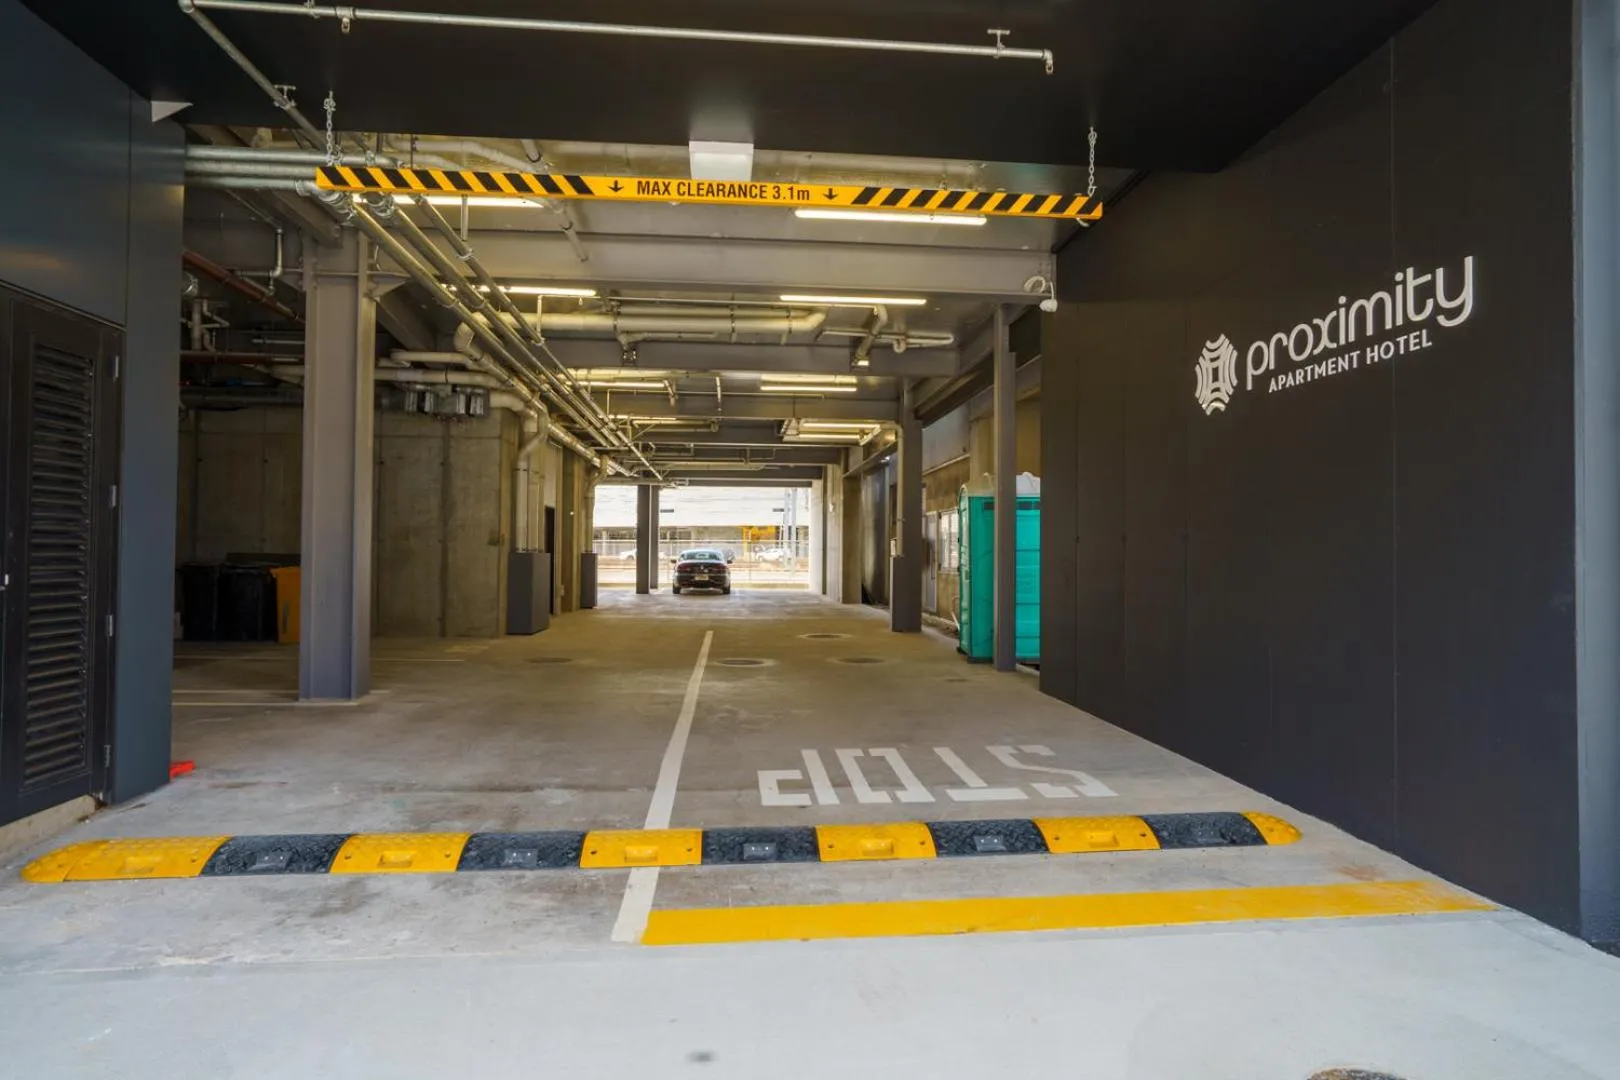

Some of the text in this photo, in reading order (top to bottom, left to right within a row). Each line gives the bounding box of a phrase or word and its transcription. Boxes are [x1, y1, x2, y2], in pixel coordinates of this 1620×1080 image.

[636, 180, 810, 200] MAX CLEARANCE 3.1m
[1246, 256, 1473, 391] proximity
[1268, 329, 1433, 393] APARTMENT HOTEL
[757, 745, 1120, 806] STOP
